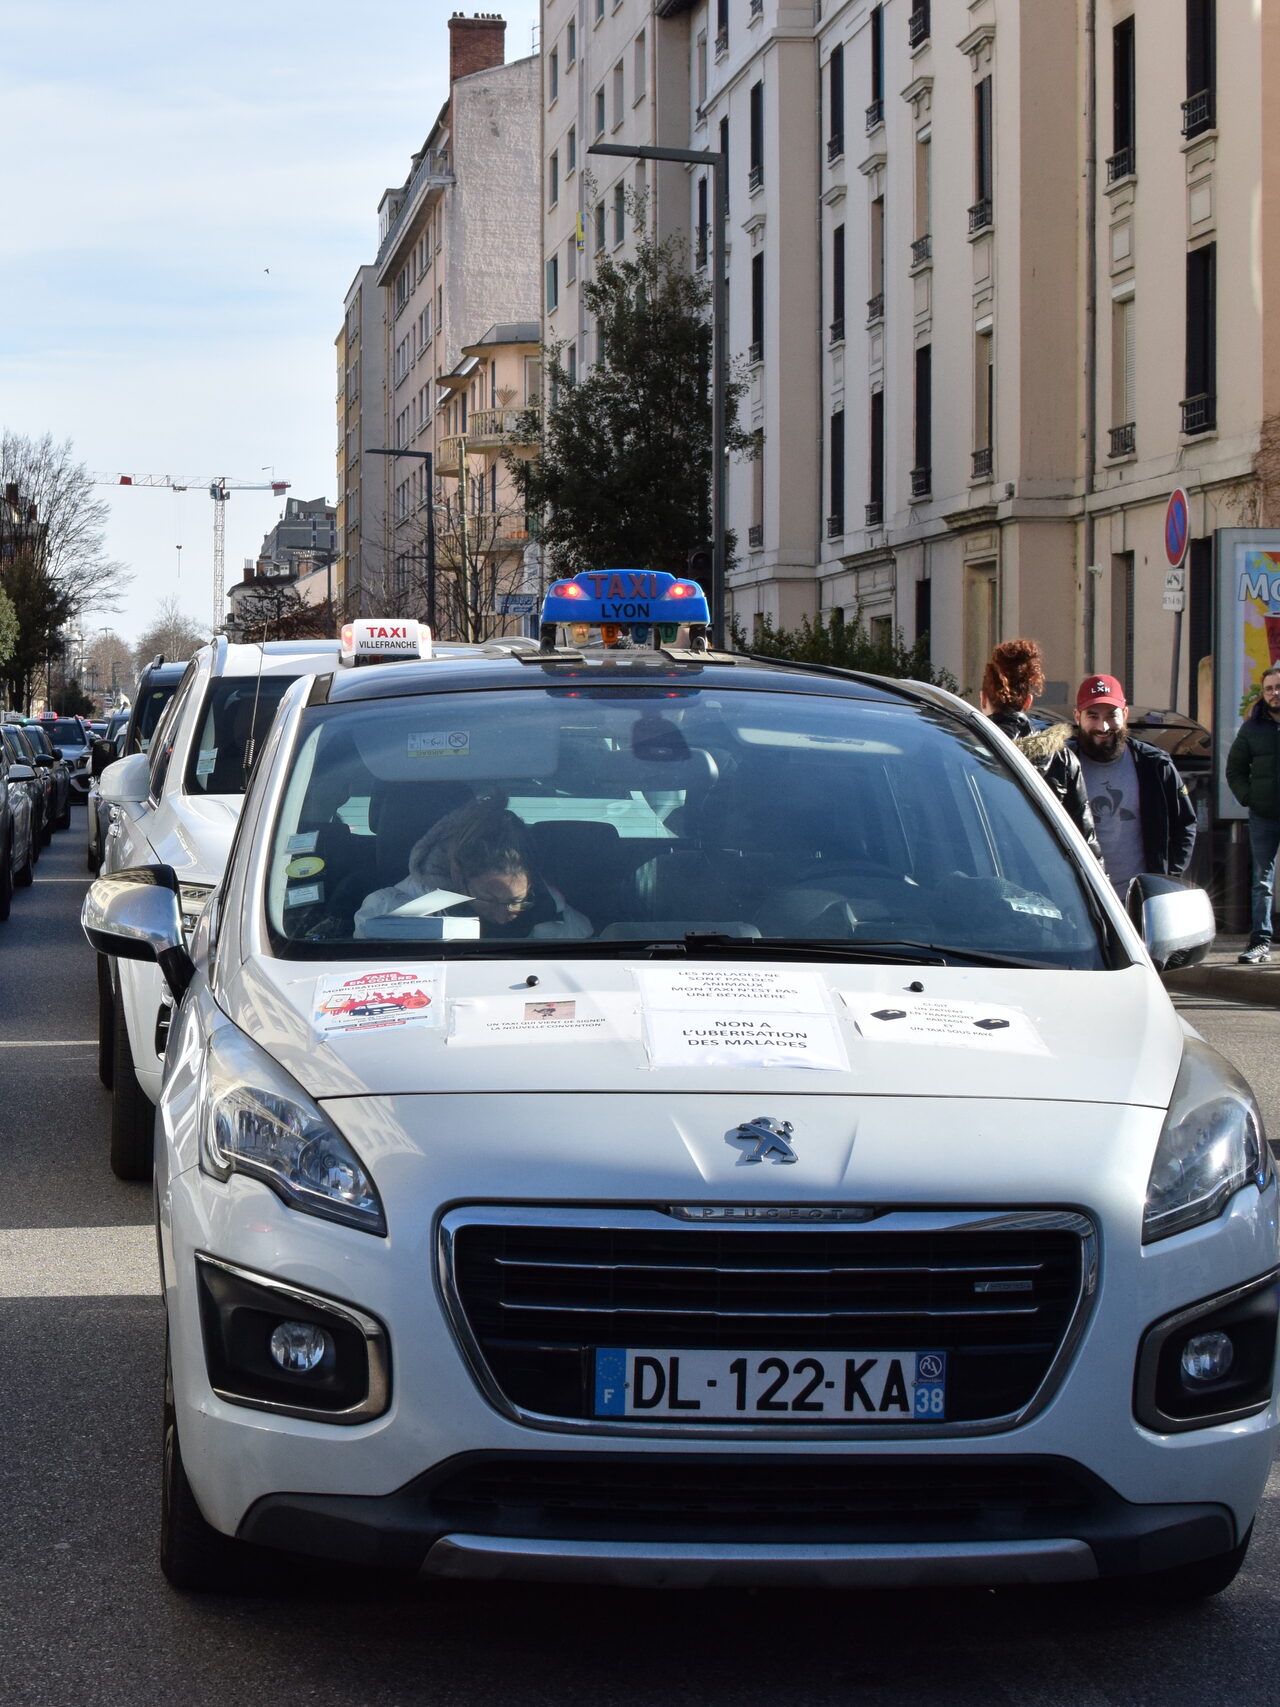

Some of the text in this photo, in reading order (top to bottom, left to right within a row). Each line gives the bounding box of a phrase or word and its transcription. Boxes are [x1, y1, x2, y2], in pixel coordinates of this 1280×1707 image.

[587, 574, 658, 599] TAXI
[601, 603, 650, 619] LYON
[366, 627, 407, 638] TAXI
[606, 625, 615, 638] B
[358, 640, 418, 650] VILLEFRANCHE
[682, 1029, 808, 1039] L'UBERISATION
[724, 1039, 808, 1048] MALADES
[702, 1207, 844, 1219] PEUGEOT
[603, 1389, 615, 1405] F
[916, 1388, 944, 1413] 38
